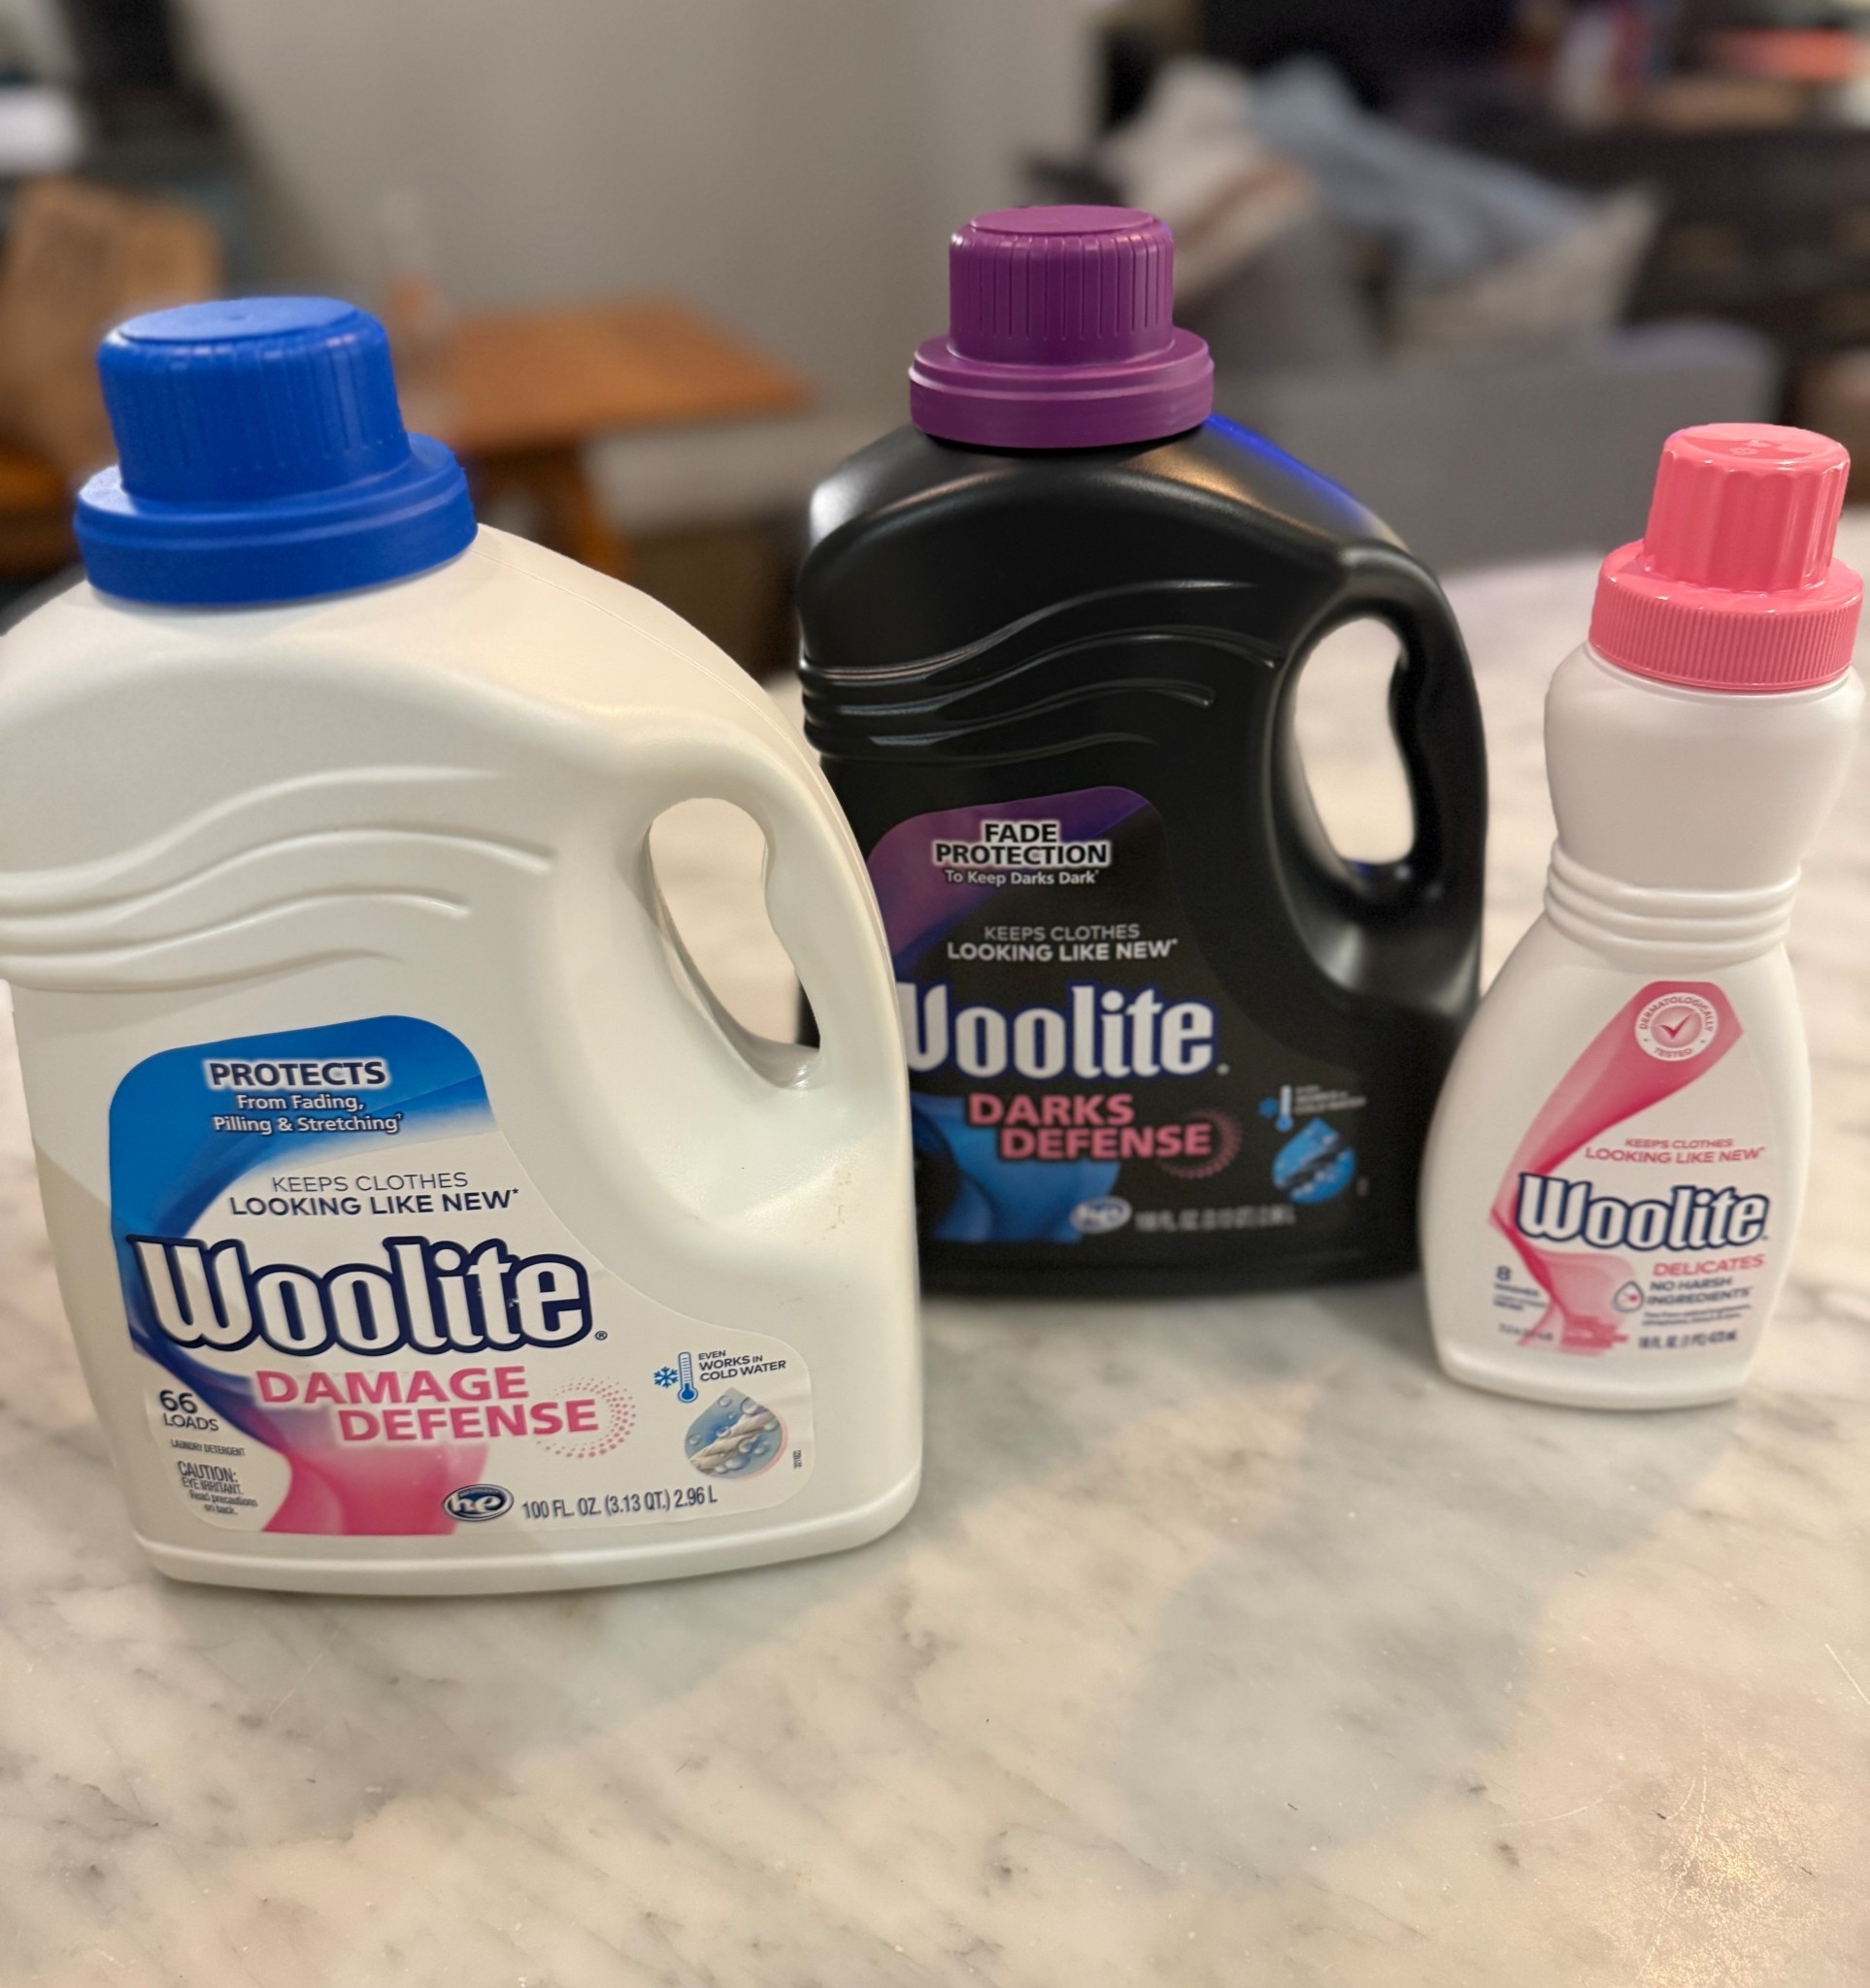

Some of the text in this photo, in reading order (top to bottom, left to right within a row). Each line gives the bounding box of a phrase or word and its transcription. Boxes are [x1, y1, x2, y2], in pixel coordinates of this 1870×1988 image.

[984, 823, 1058, 844] FADE
[935, 844, 1108, 864] PROTECTION
[945, 870, 964, 883] To
[967, 871, 1007, 887] Keep
[1010, 872, 1055, 885] Darks
[984, 923, 1141, 942] KEEPS CLOTHES
[947, 942, 1053, 961] LOOKING
[1057, 943, 1110, 961] LIKE
[1639, 996, 1715, 1032] DERMATOLOGICALLY
[1653, 1047, 1694, 1058] TESTED
[209, 1060, 386, 1087] PROTECTS
[236, 1094, 365, 1112] From Fading,
[967, 1092, 1136, 1128] DARKS
[213, 1115, 273, 1136] Pilling
[278, 1117, 293, 1132] &
[999, 1124, 1214, 1160] DEFENSE
[1624, 1138, 1734, 1149] KEEPS CLOTHES
[1585, 1146, 1671, 1164] LOOKING
[1676, 1150, 1715, 1164] LIKE
[271, 1171, 469, 1193] KEEPS CLOTHES
[228, 1196, 362, 1216] LOOKING
[370, 1194, 435, 1215] LIKE
[1515, 1172, 1770, 1251] Woolite
[1496, 1265, 1512, 1281] 8
[1652, 1253, 1766, 1276] DELICATES
[1650, 1276, 1732, 1292] NO HARSH
[124, 1234, 594, 1357] Woolite
[697, 1349, 726, 1361] EVEN
[698, 1354, 763, 1371] WORKS IN
[699, 1359, 787, 1382] COLD WATER
[255, 1366, 530, 1405] DAMAGE
[159, 1389, 198, 1414] 66
[163, 1412, 219, 1432] LOADS
[337, 1399, 600, 1442] DEFENSE
[204, 1443, 246, 1457] DETERGENT
[177, 1460, 239, 1483] CAUTION:
[181, 1476, 245, 1496] EYE IRRITANT.
[522, 1484, 718, 1519] 100 FL. OZ. (3.13 QT.) 2.96 L
